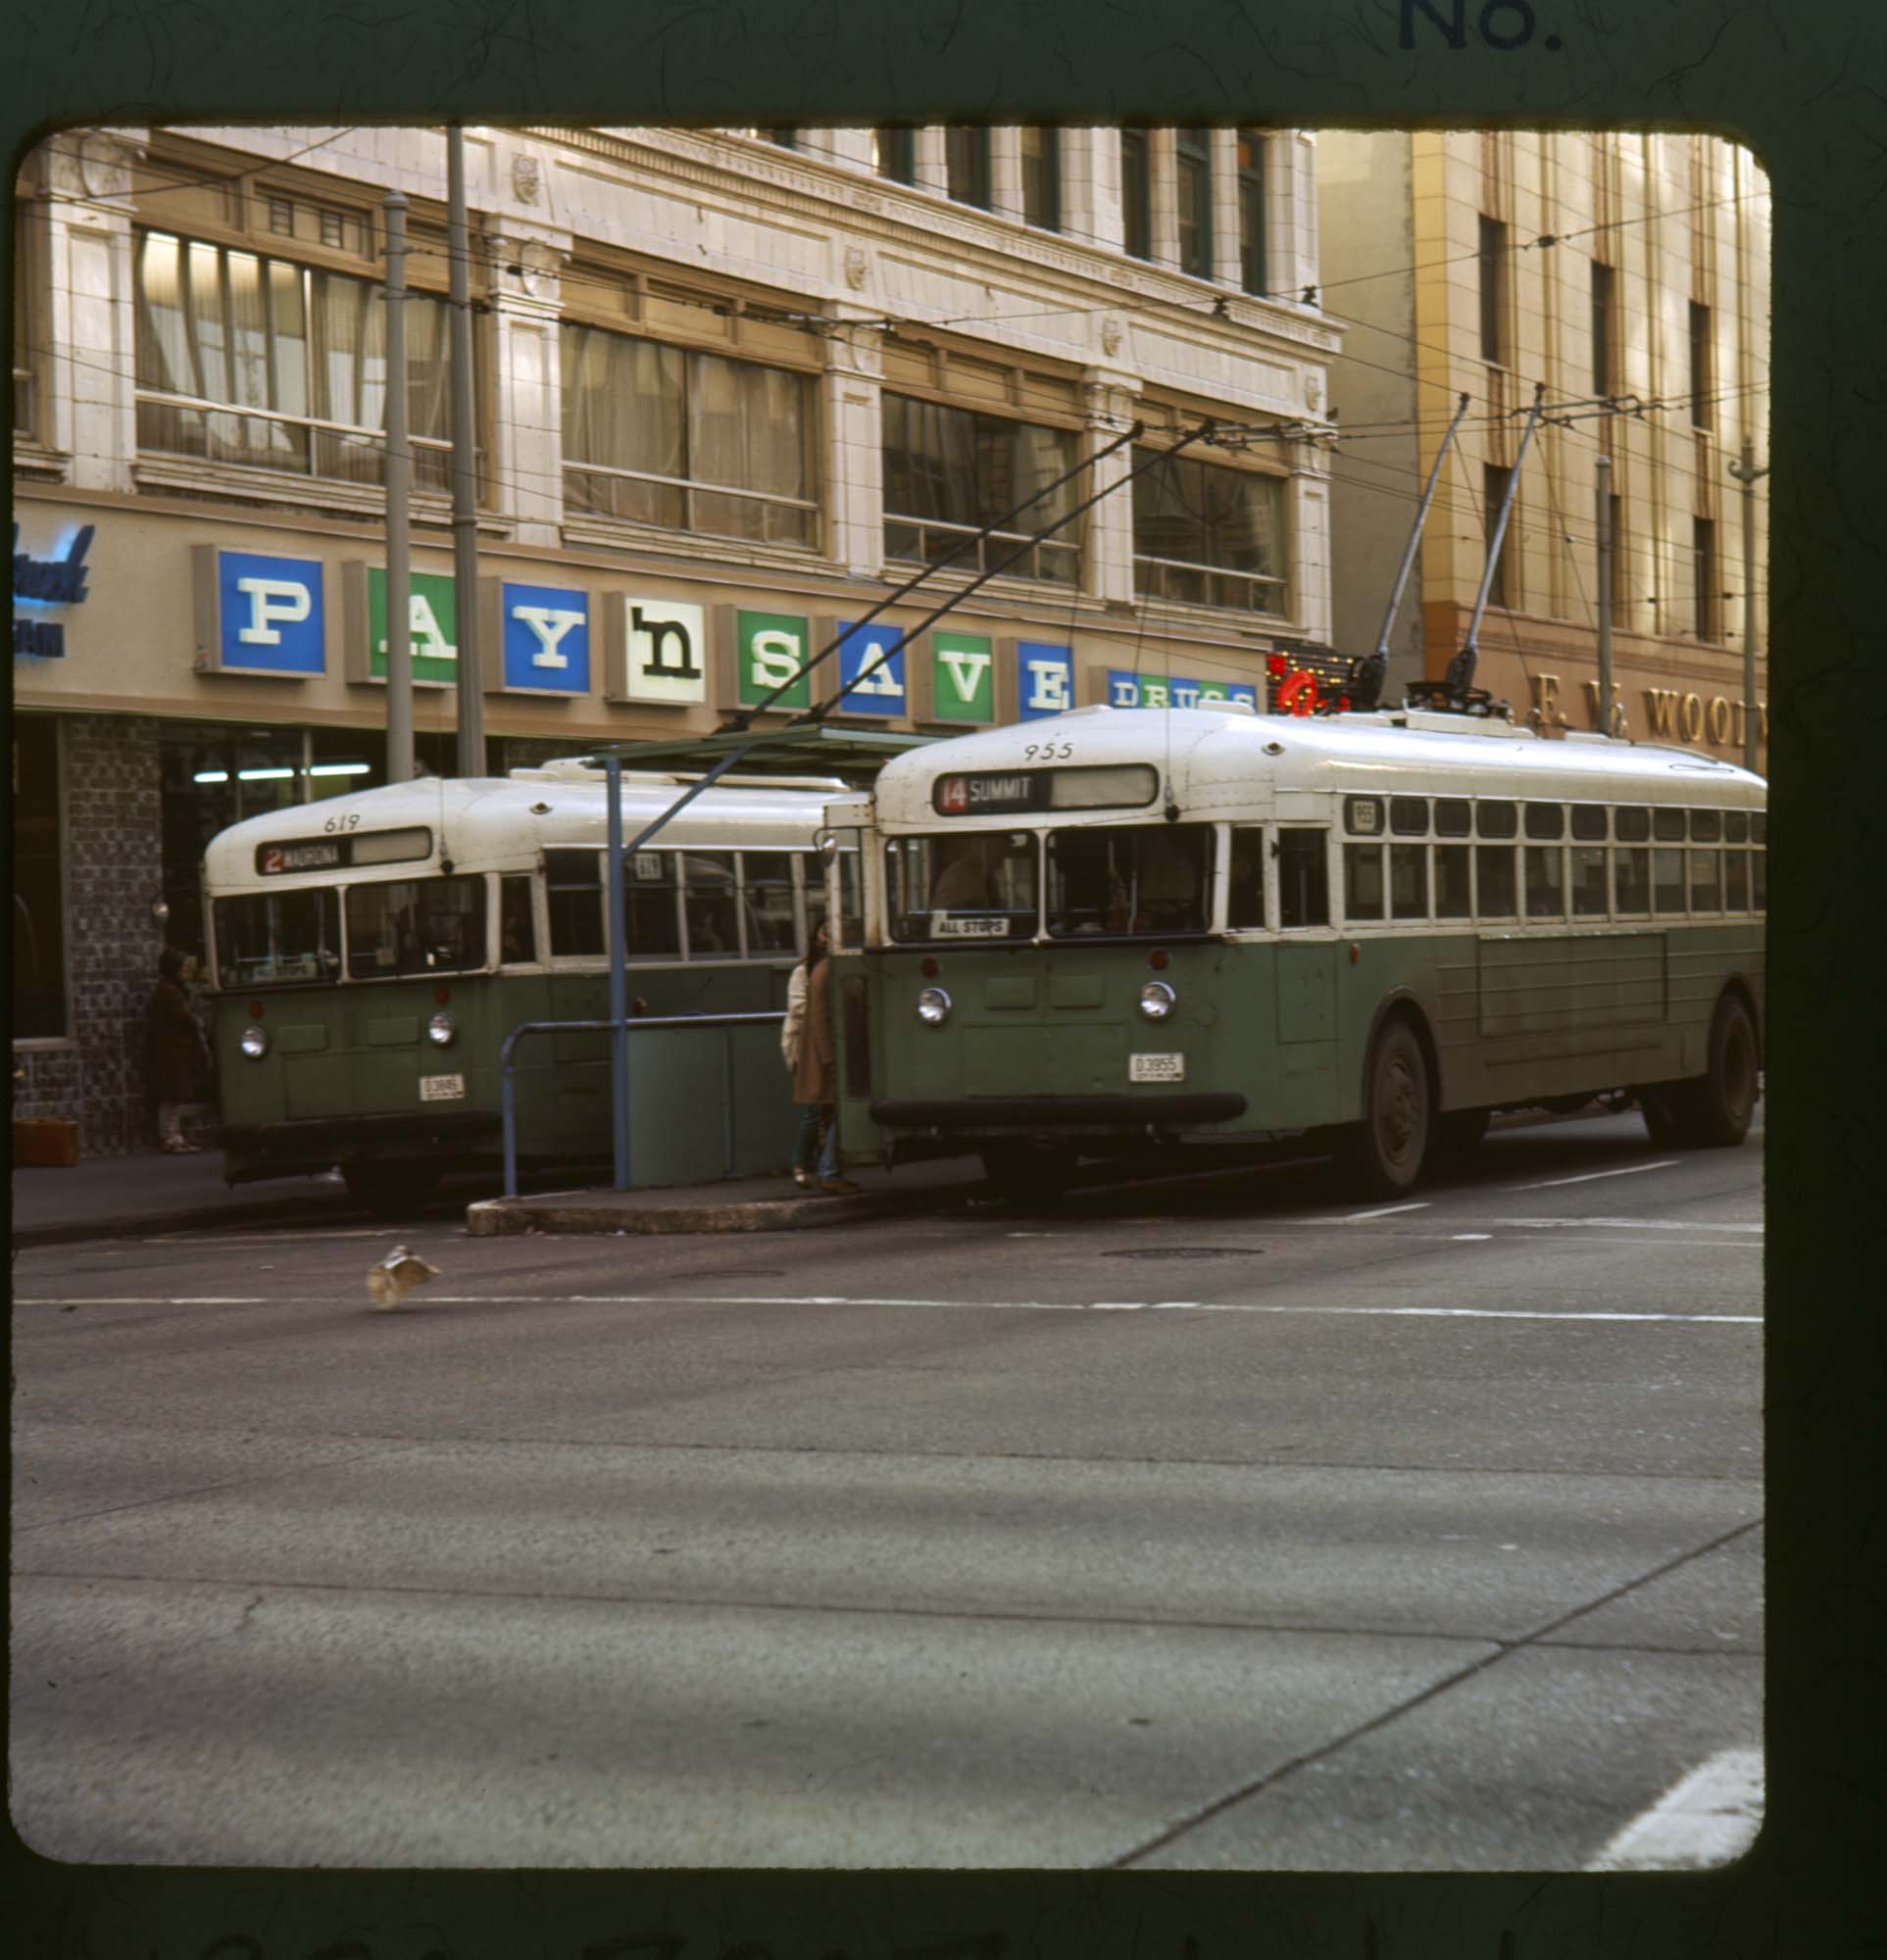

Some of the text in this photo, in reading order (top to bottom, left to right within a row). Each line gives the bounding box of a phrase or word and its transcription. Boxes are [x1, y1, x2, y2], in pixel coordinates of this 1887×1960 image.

[1398, 0, 1563, 51] No.
[237, 576, 1069, 710] PAY n SAVE
[1646, 687, 1767, 747] WOO
[1024, 743, 1074, 761] 955
[942, 777, 1033, 807] 14 SUMMIT
[324, 813, 361, 833] 619
[264, 849, 283, 872] 2
[939, 920, 1004, 933] ALL STOPS
